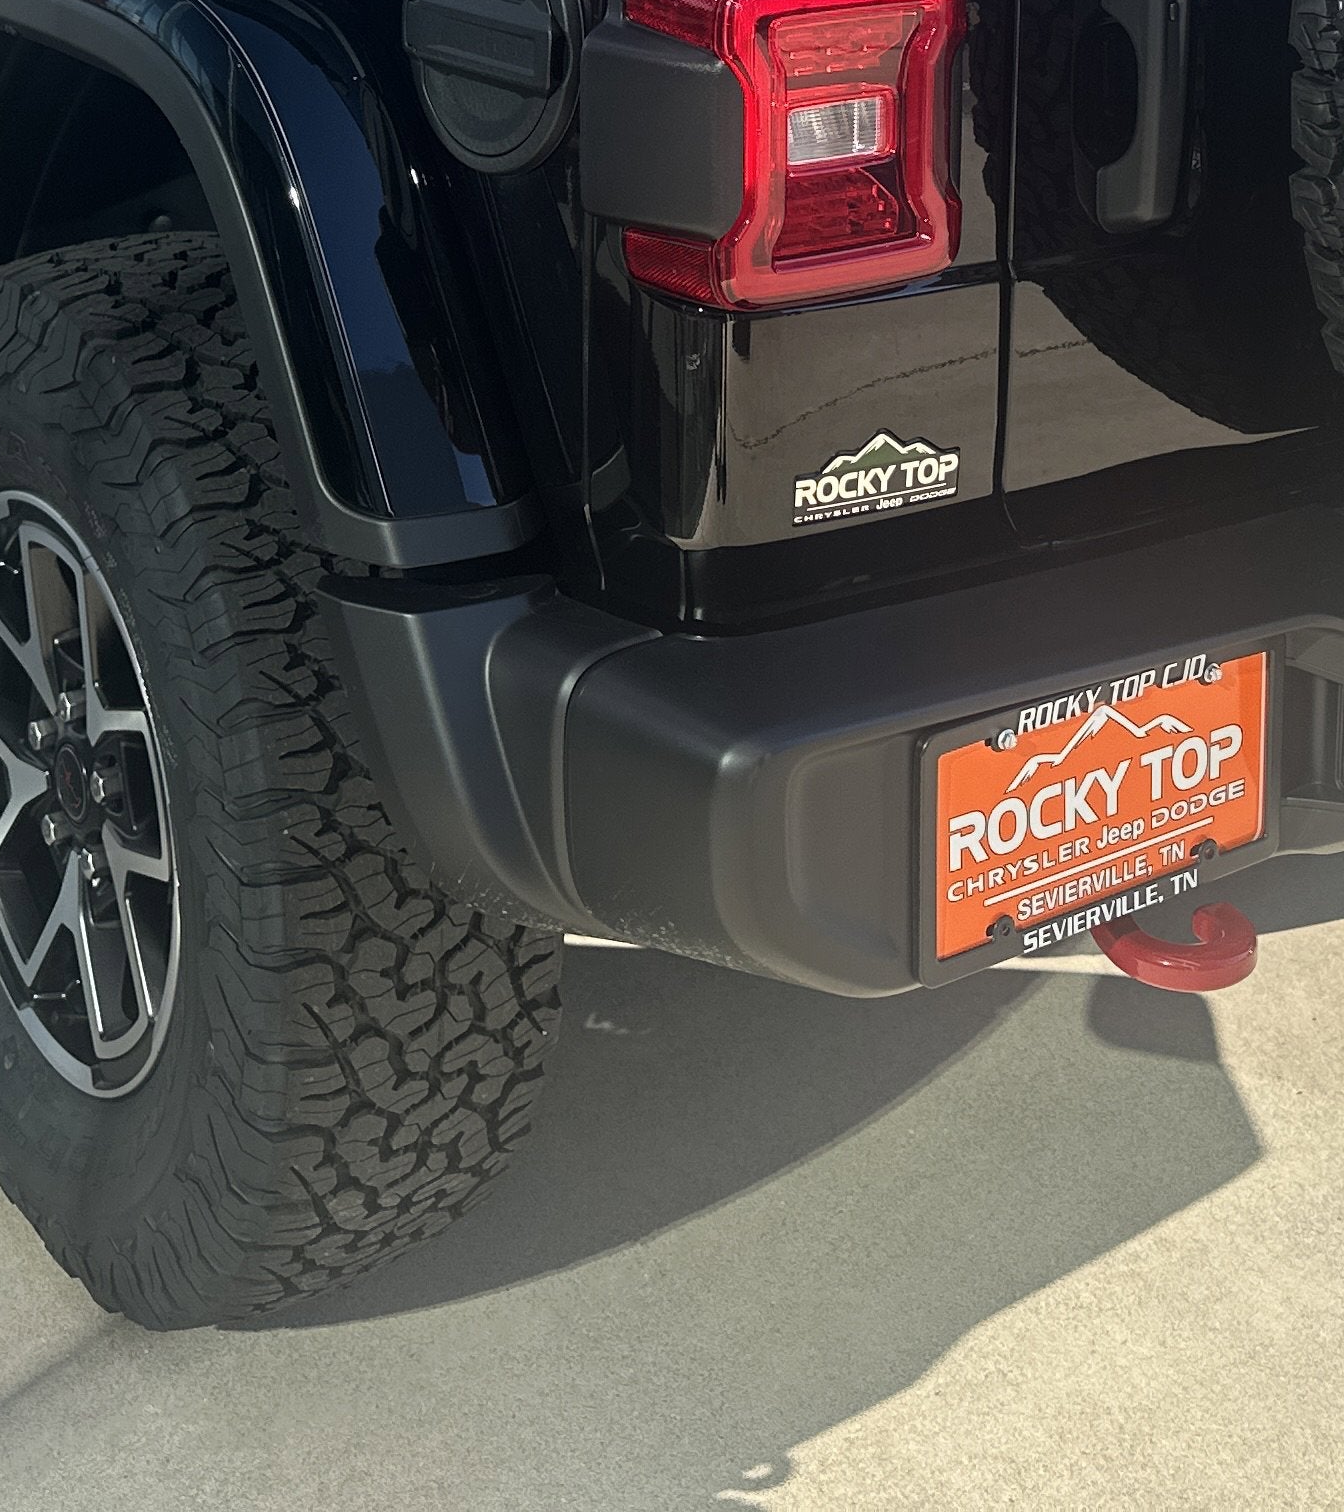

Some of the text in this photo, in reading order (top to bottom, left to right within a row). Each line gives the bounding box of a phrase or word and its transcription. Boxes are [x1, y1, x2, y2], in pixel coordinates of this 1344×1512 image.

[793, 487, 957, 524] CHRYSLER Jeep DODGE
[794, 453, 959, 508] ROCKY TOP
[1017, 653, 1207, 736] ROCKY TOP CJD
[947, 723, 1244, 873] ROCKY TOP
[946, 779, 1246, 903] CHRYSLER Jeep DODGE
[1017, 839, 1186, 922] SEVIERVILLE, TN
[1023, 868, 1199, 955] SEVIERVILLE, TN
